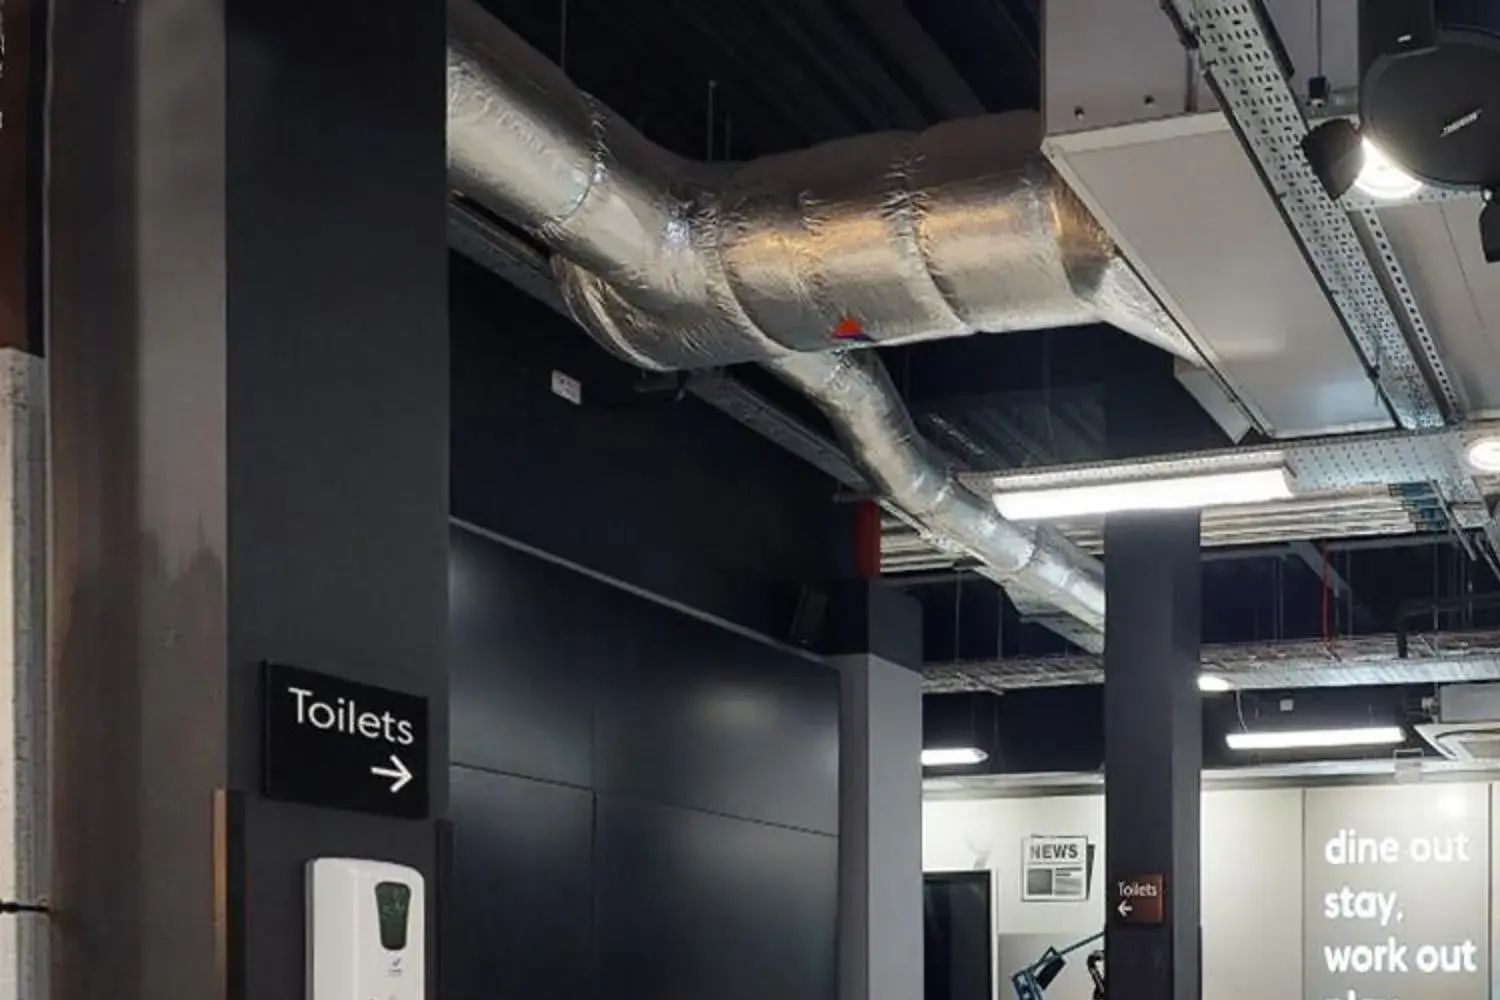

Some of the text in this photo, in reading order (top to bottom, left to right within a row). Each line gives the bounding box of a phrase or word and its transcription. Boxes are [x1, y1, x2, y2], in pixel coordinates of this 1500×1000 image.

[288, 685, 415, 747] Toilets
[1029, 843, 1079, 860] NEWS
[1324, 829, 1471, 865] dine out
[1117, 881, 1159, 898] Toilets
[1323, 886, 1404, 927] stay,
[1323, 937, 1478, 974] work out
